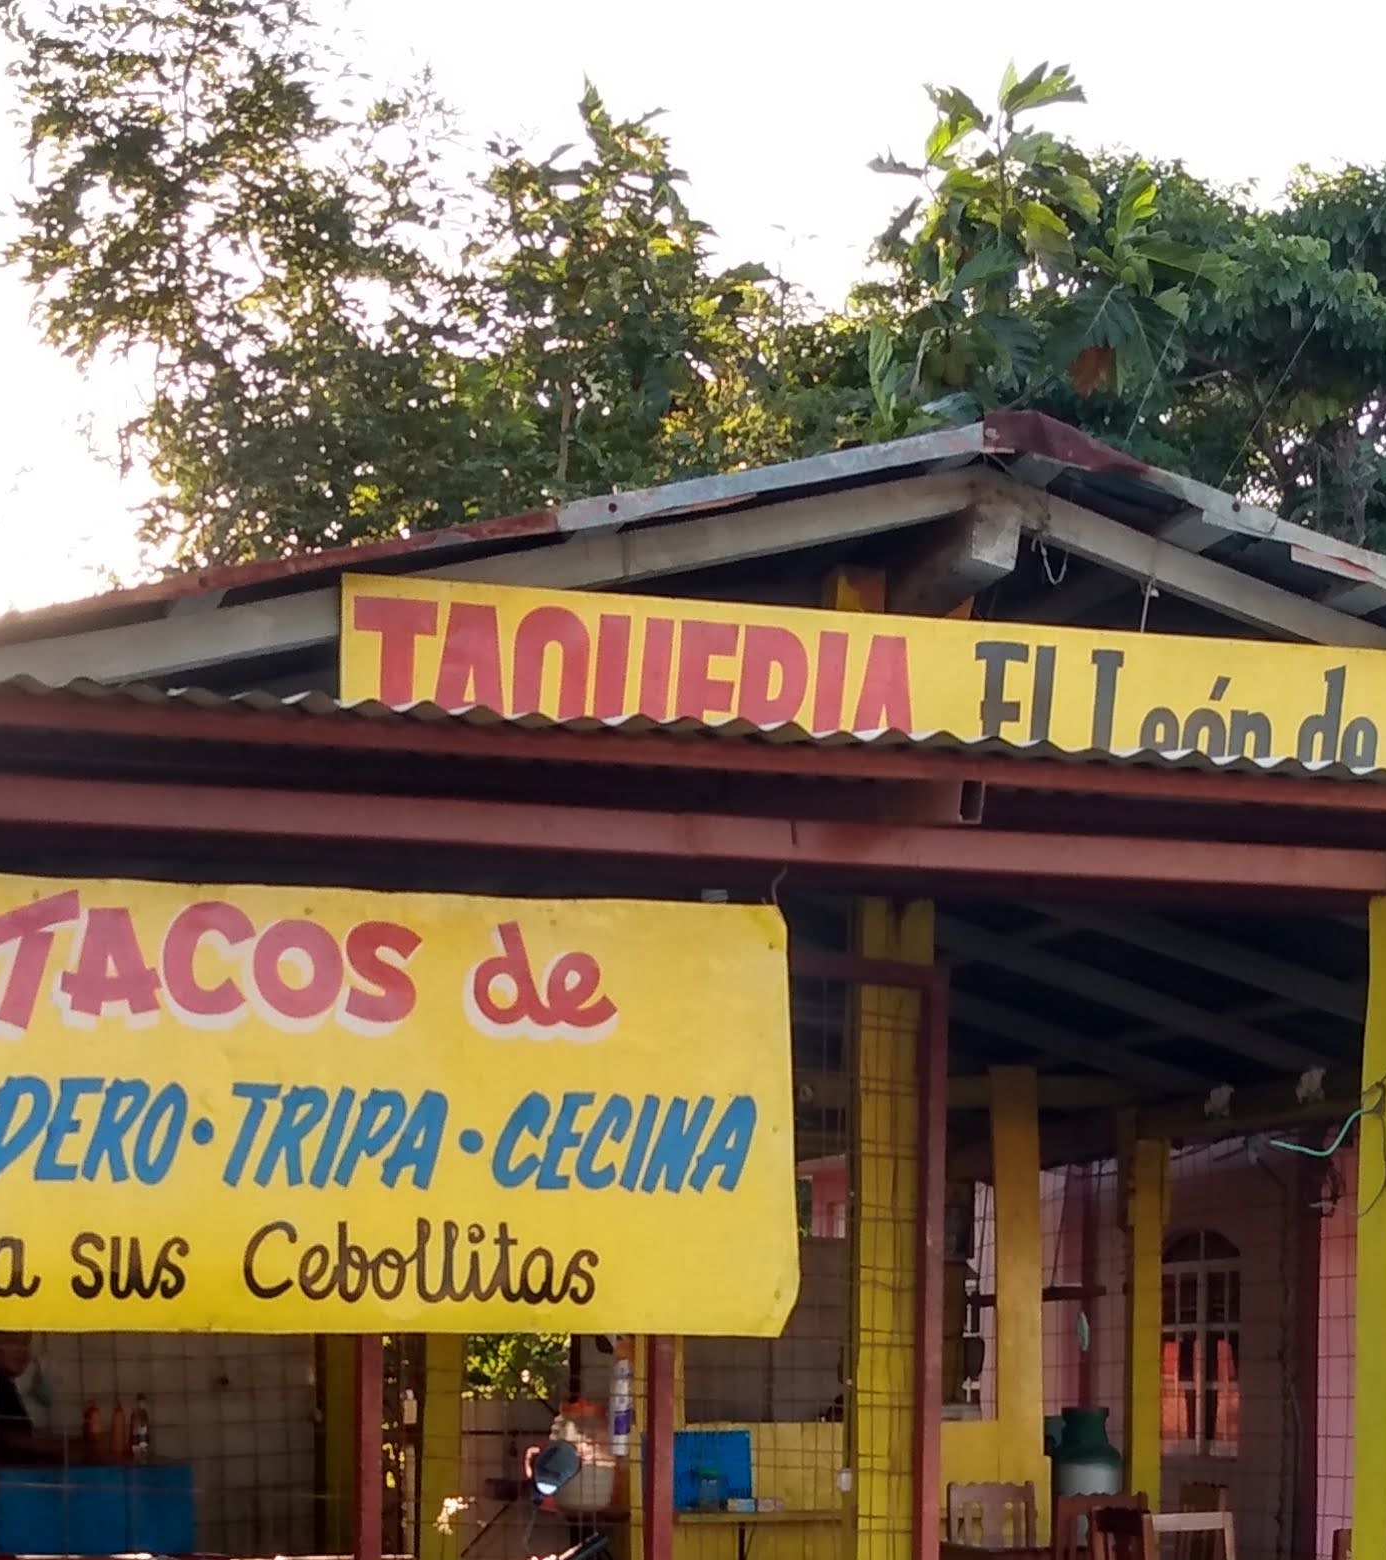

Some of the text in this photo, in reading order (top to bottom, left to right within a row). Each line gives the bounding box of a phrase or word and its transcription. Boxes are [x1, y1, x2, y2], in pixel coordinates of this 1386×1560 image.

[469, 921, 618, 1032] de
[223, 1082, 447, 1190] TRIPA
[492, 1093, 758, 1192] CECINA
[71, 1232, 191, 1301] sus
[243, 1218, 600, 1306] Cebollitas
